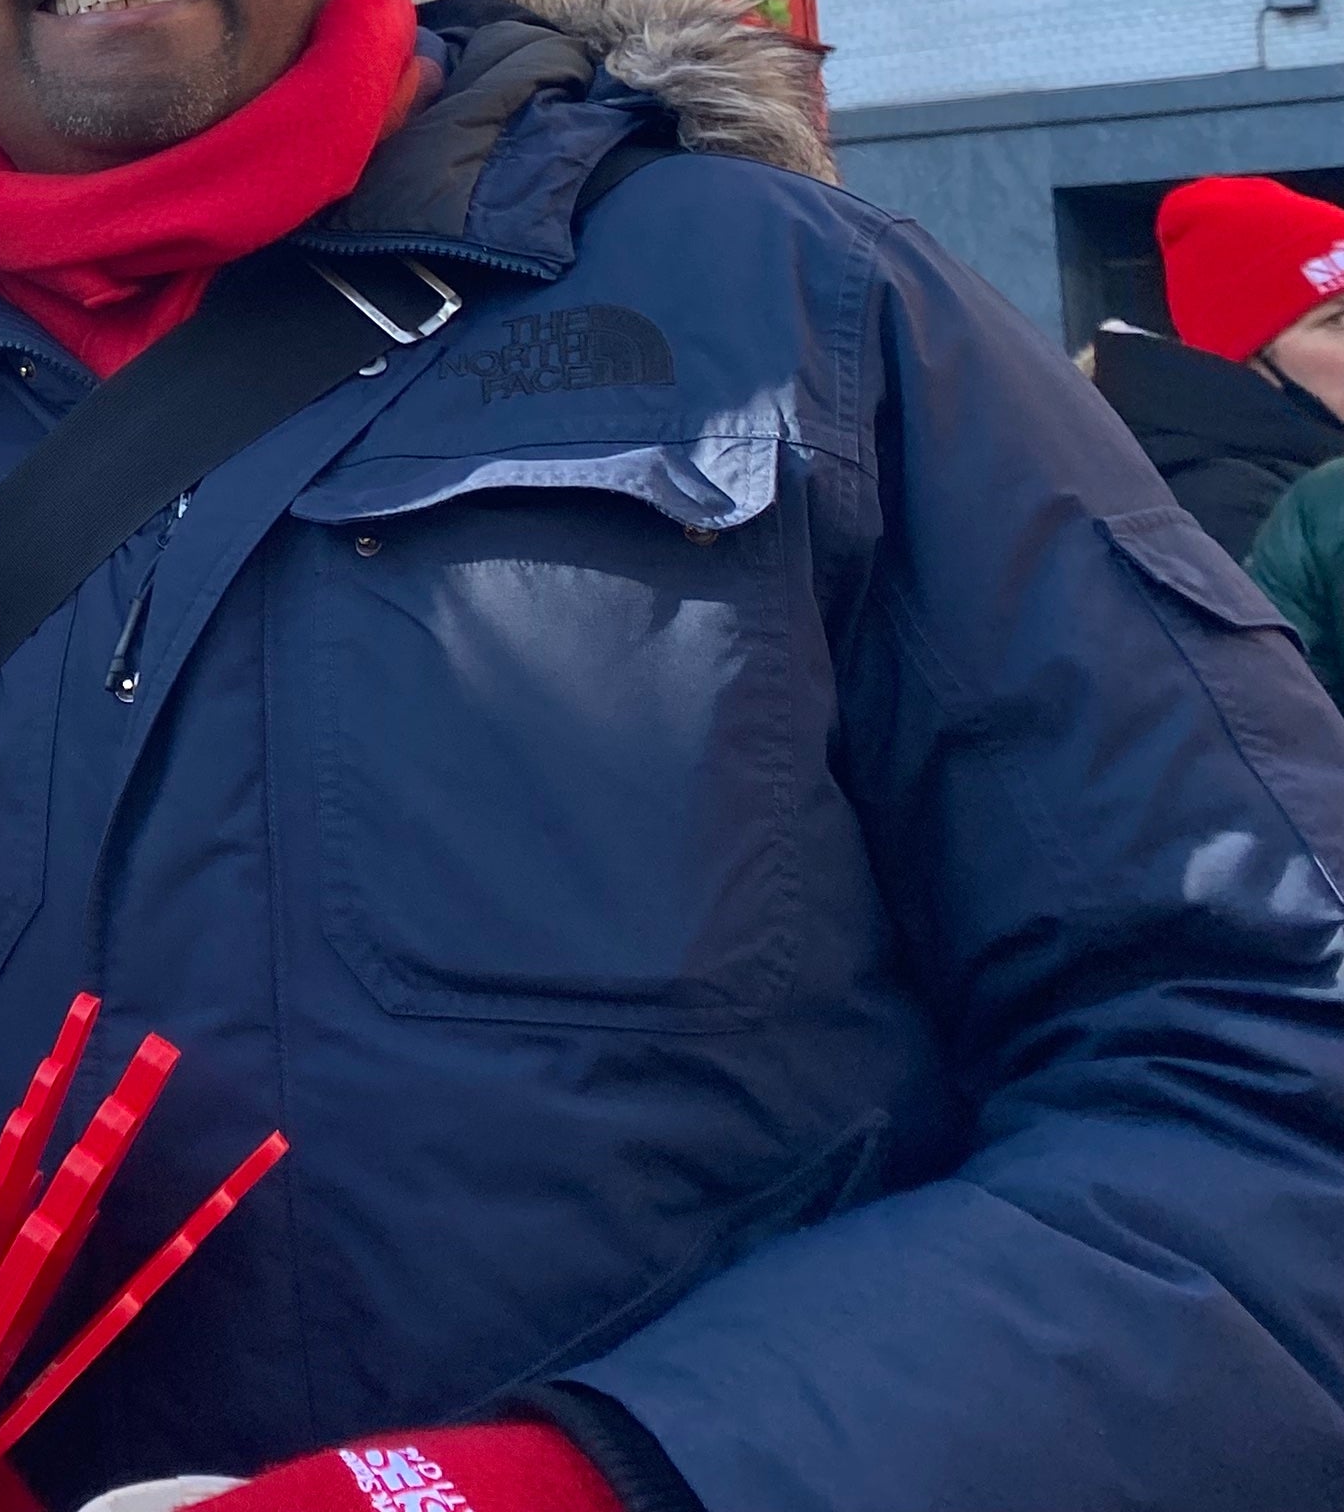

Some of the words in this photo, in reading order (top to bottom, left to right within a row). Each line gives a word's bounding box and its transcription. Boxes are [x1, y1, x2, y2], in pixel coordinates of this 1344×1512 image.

[502, 306, 591, 346] THE
[437, 333, 591, 381] NORTH
[480, 363, 593, 405] FACE
